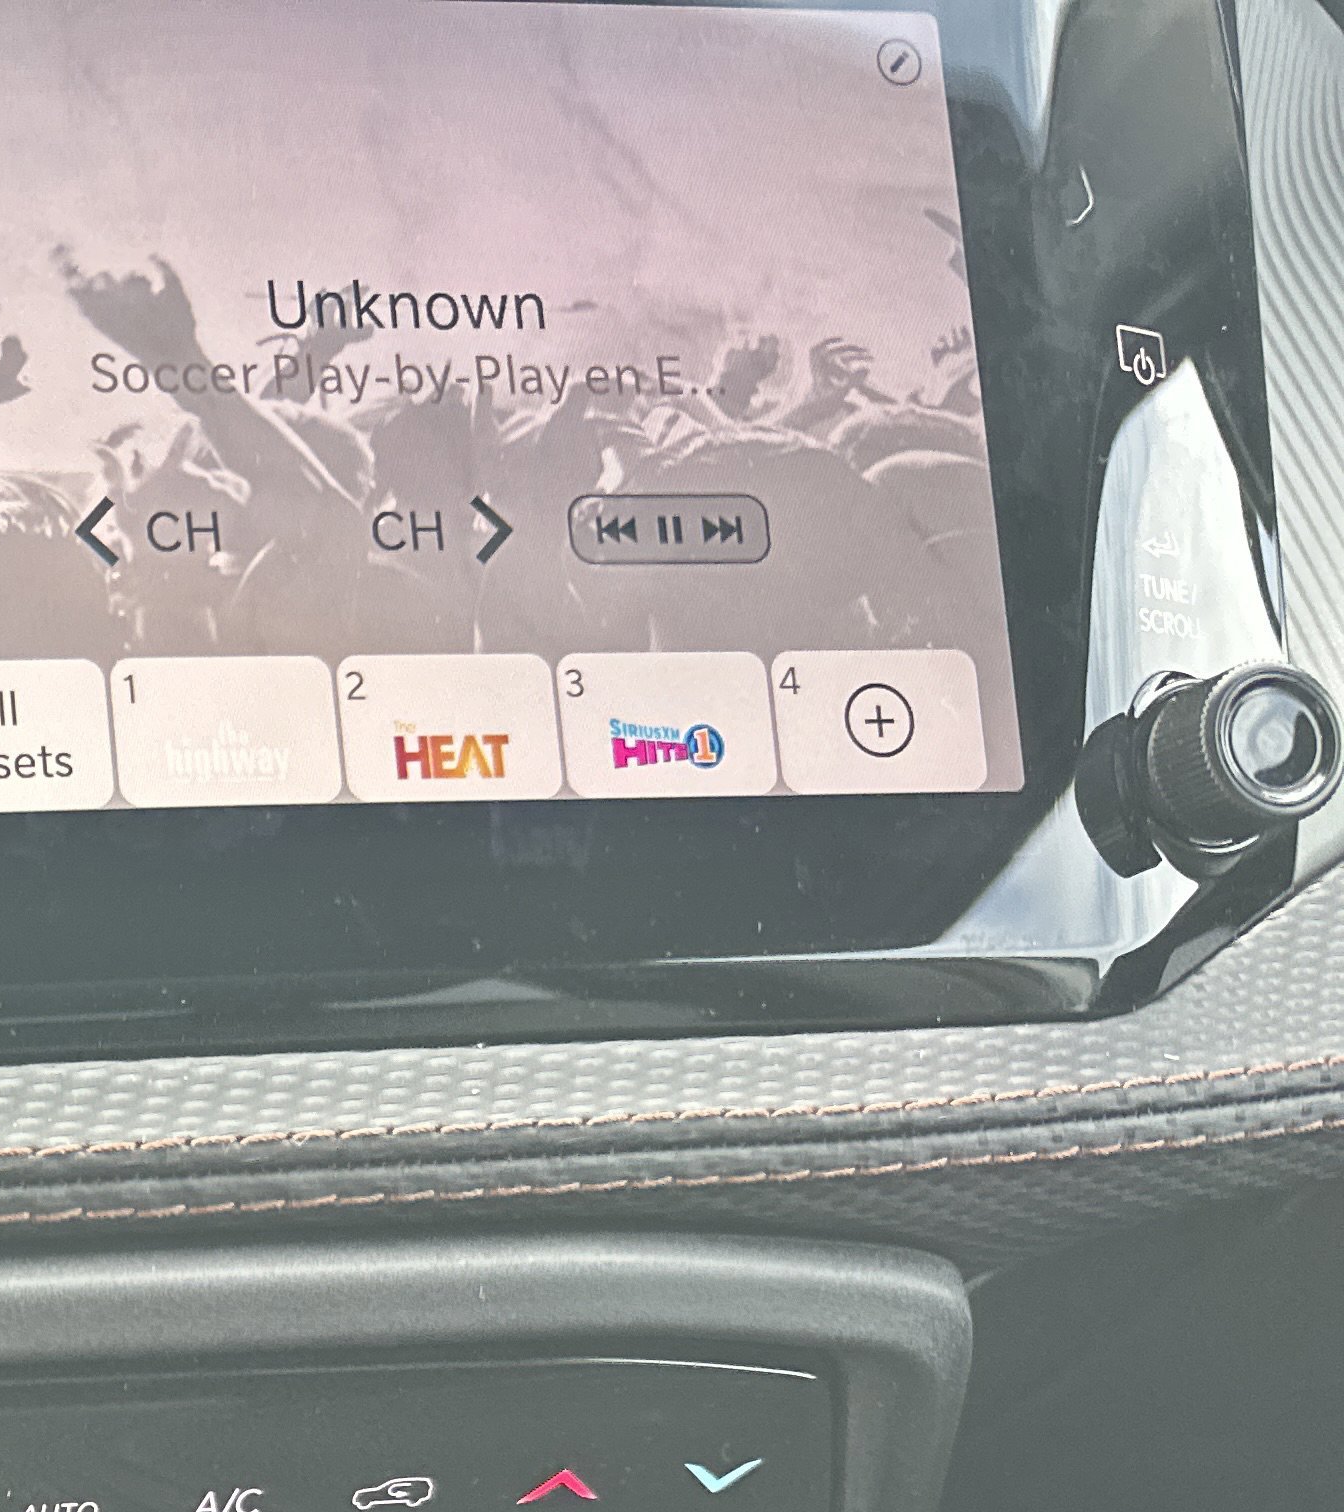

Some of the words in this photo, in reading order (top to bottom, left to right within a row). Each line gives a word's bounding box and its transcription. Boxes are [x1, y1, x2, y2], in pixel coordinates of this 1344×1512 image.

[268, 278, 546, 331] Unknown
[90, 352, 258, 396] Soccer
[272, 352, 570, 404] Play-by-Play
[585, 362, 641, 394] en
[146, 510, 221, 553] CH
[371, 511, 445, 552] CH
[123, 674, 137, 704] 1
[345, 672, 366, 700] 2
[565, 669, 584, 697] 3
[779, 667, 800, 695] 4
[394, 734, 509, 779] HEAT
